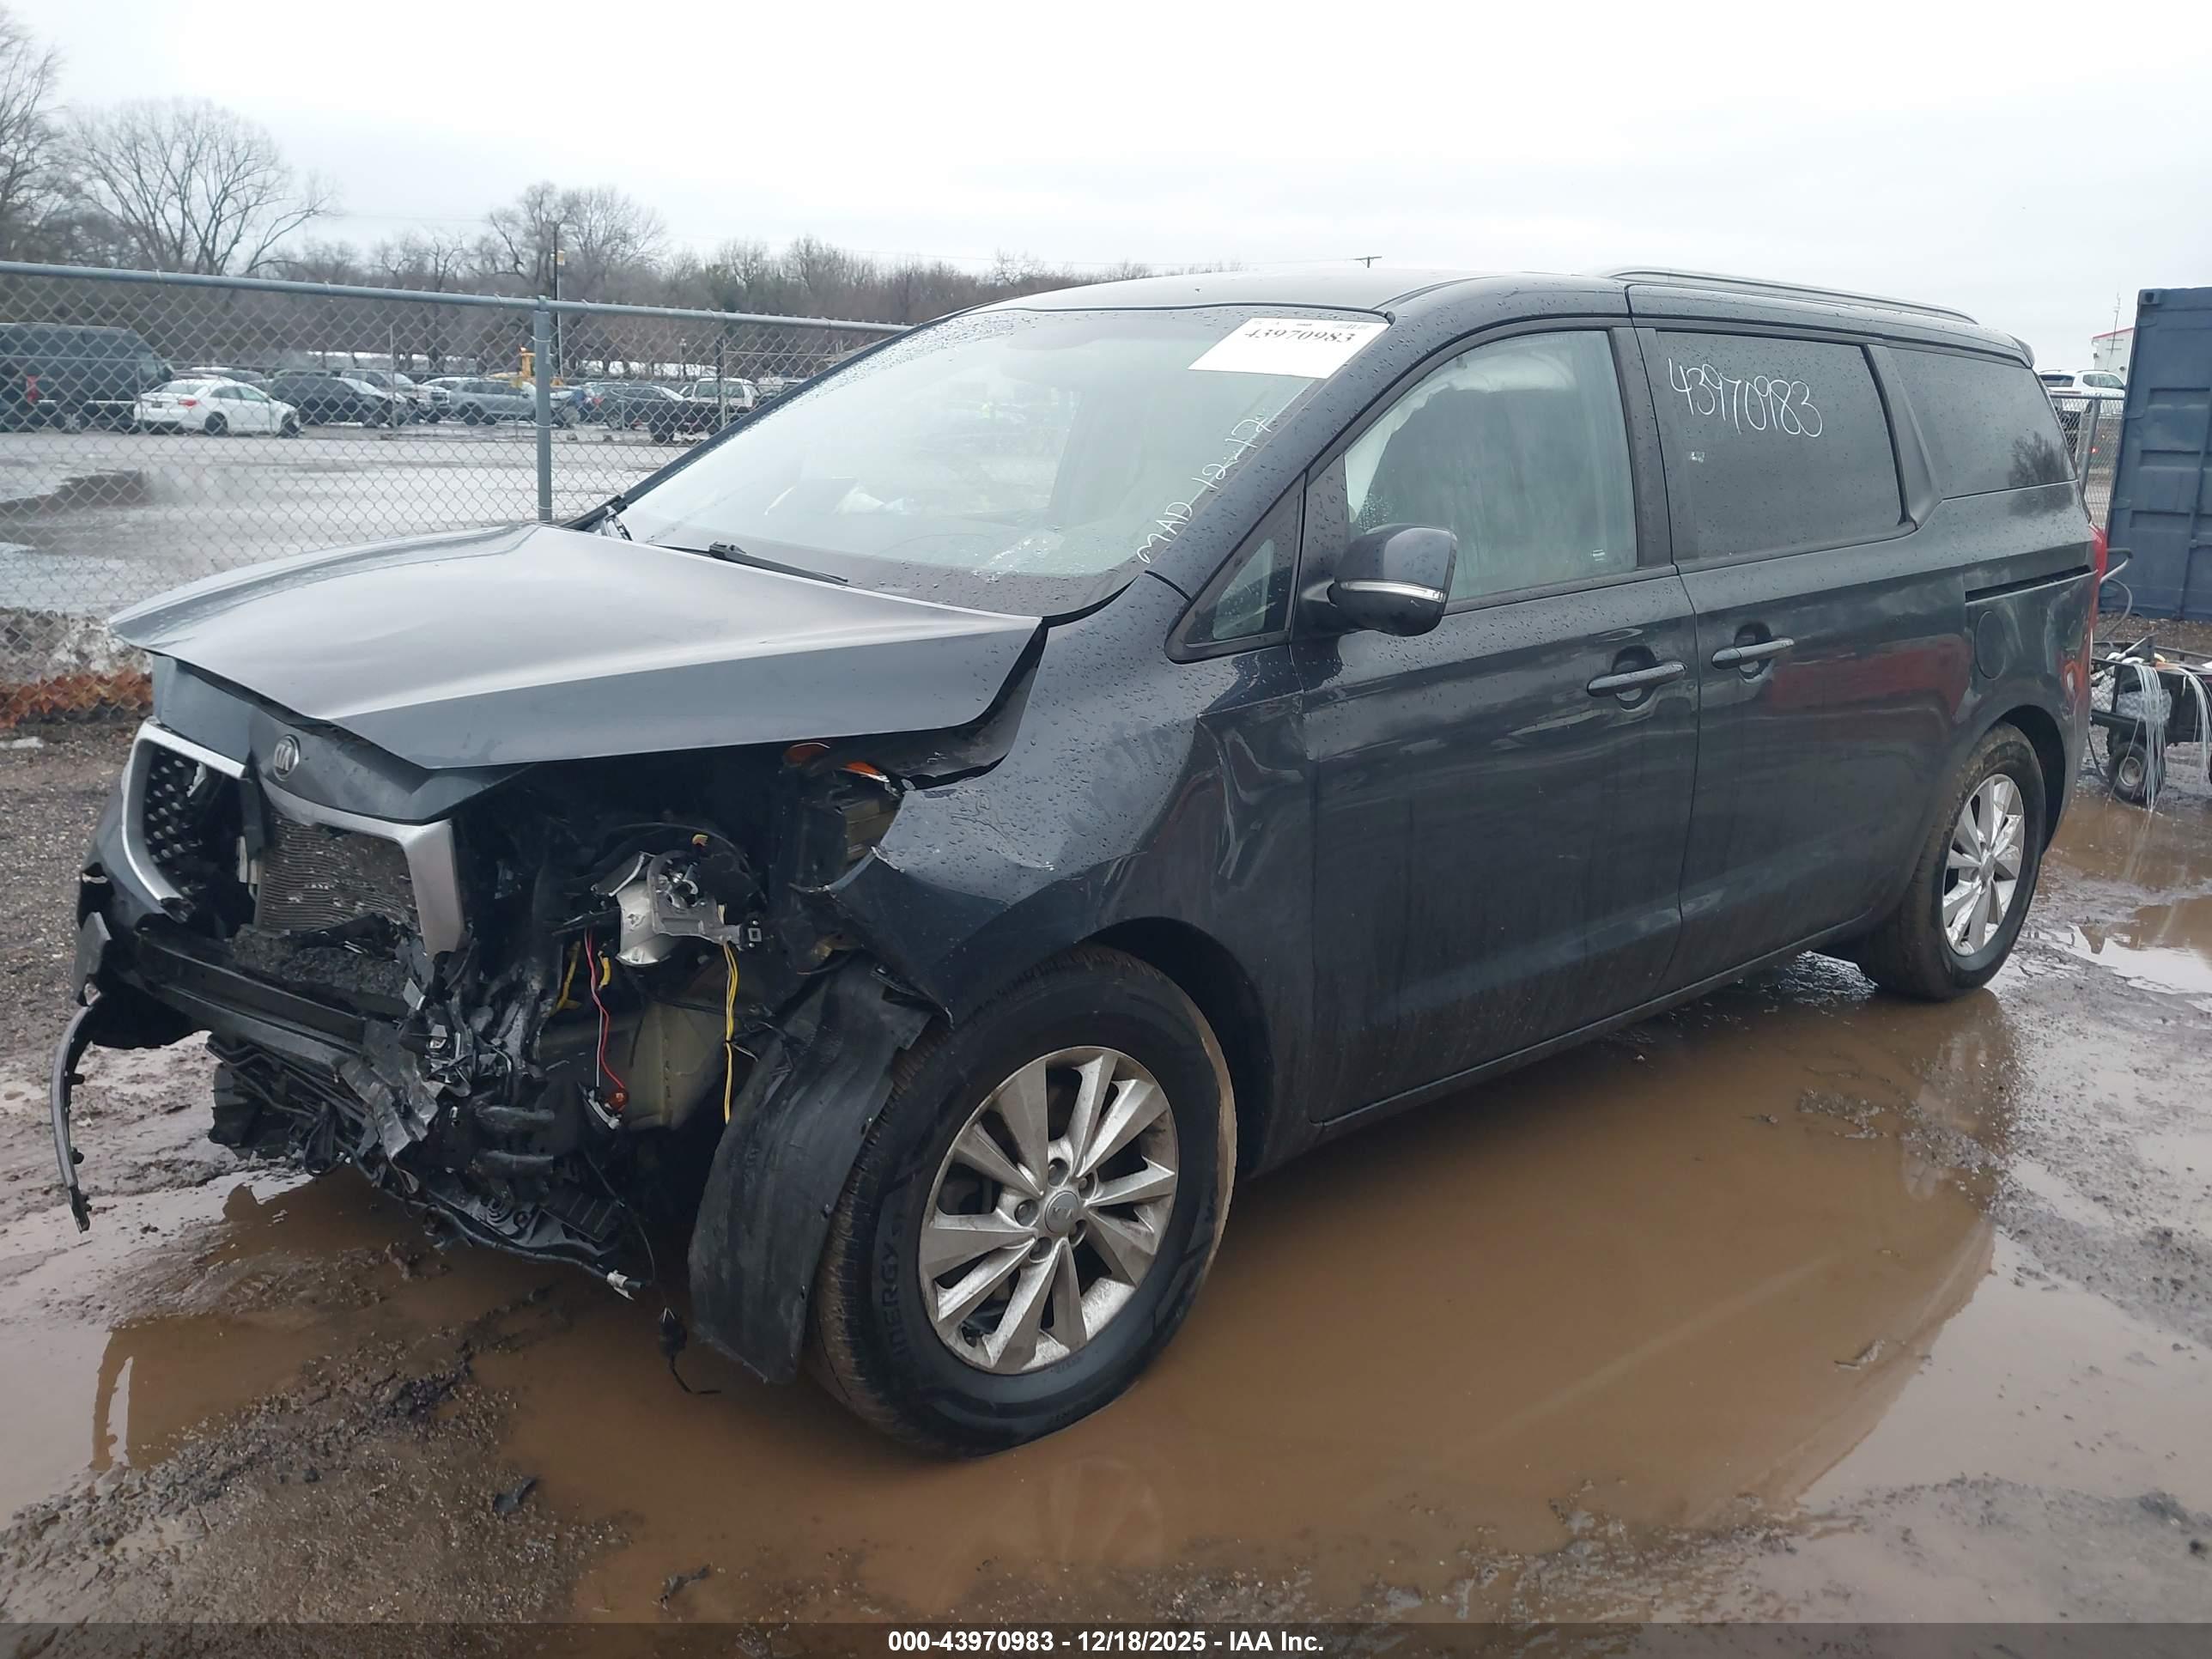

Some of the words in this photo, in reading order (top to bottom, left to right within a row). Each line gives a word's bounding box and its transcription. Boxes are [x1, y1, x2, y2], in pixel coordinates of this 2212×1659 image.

[1245, 328, 1356, 343] 43970983
[1668, 357, 1823, 438] 43970983
[1136, 501, 1194, 564] MAD
